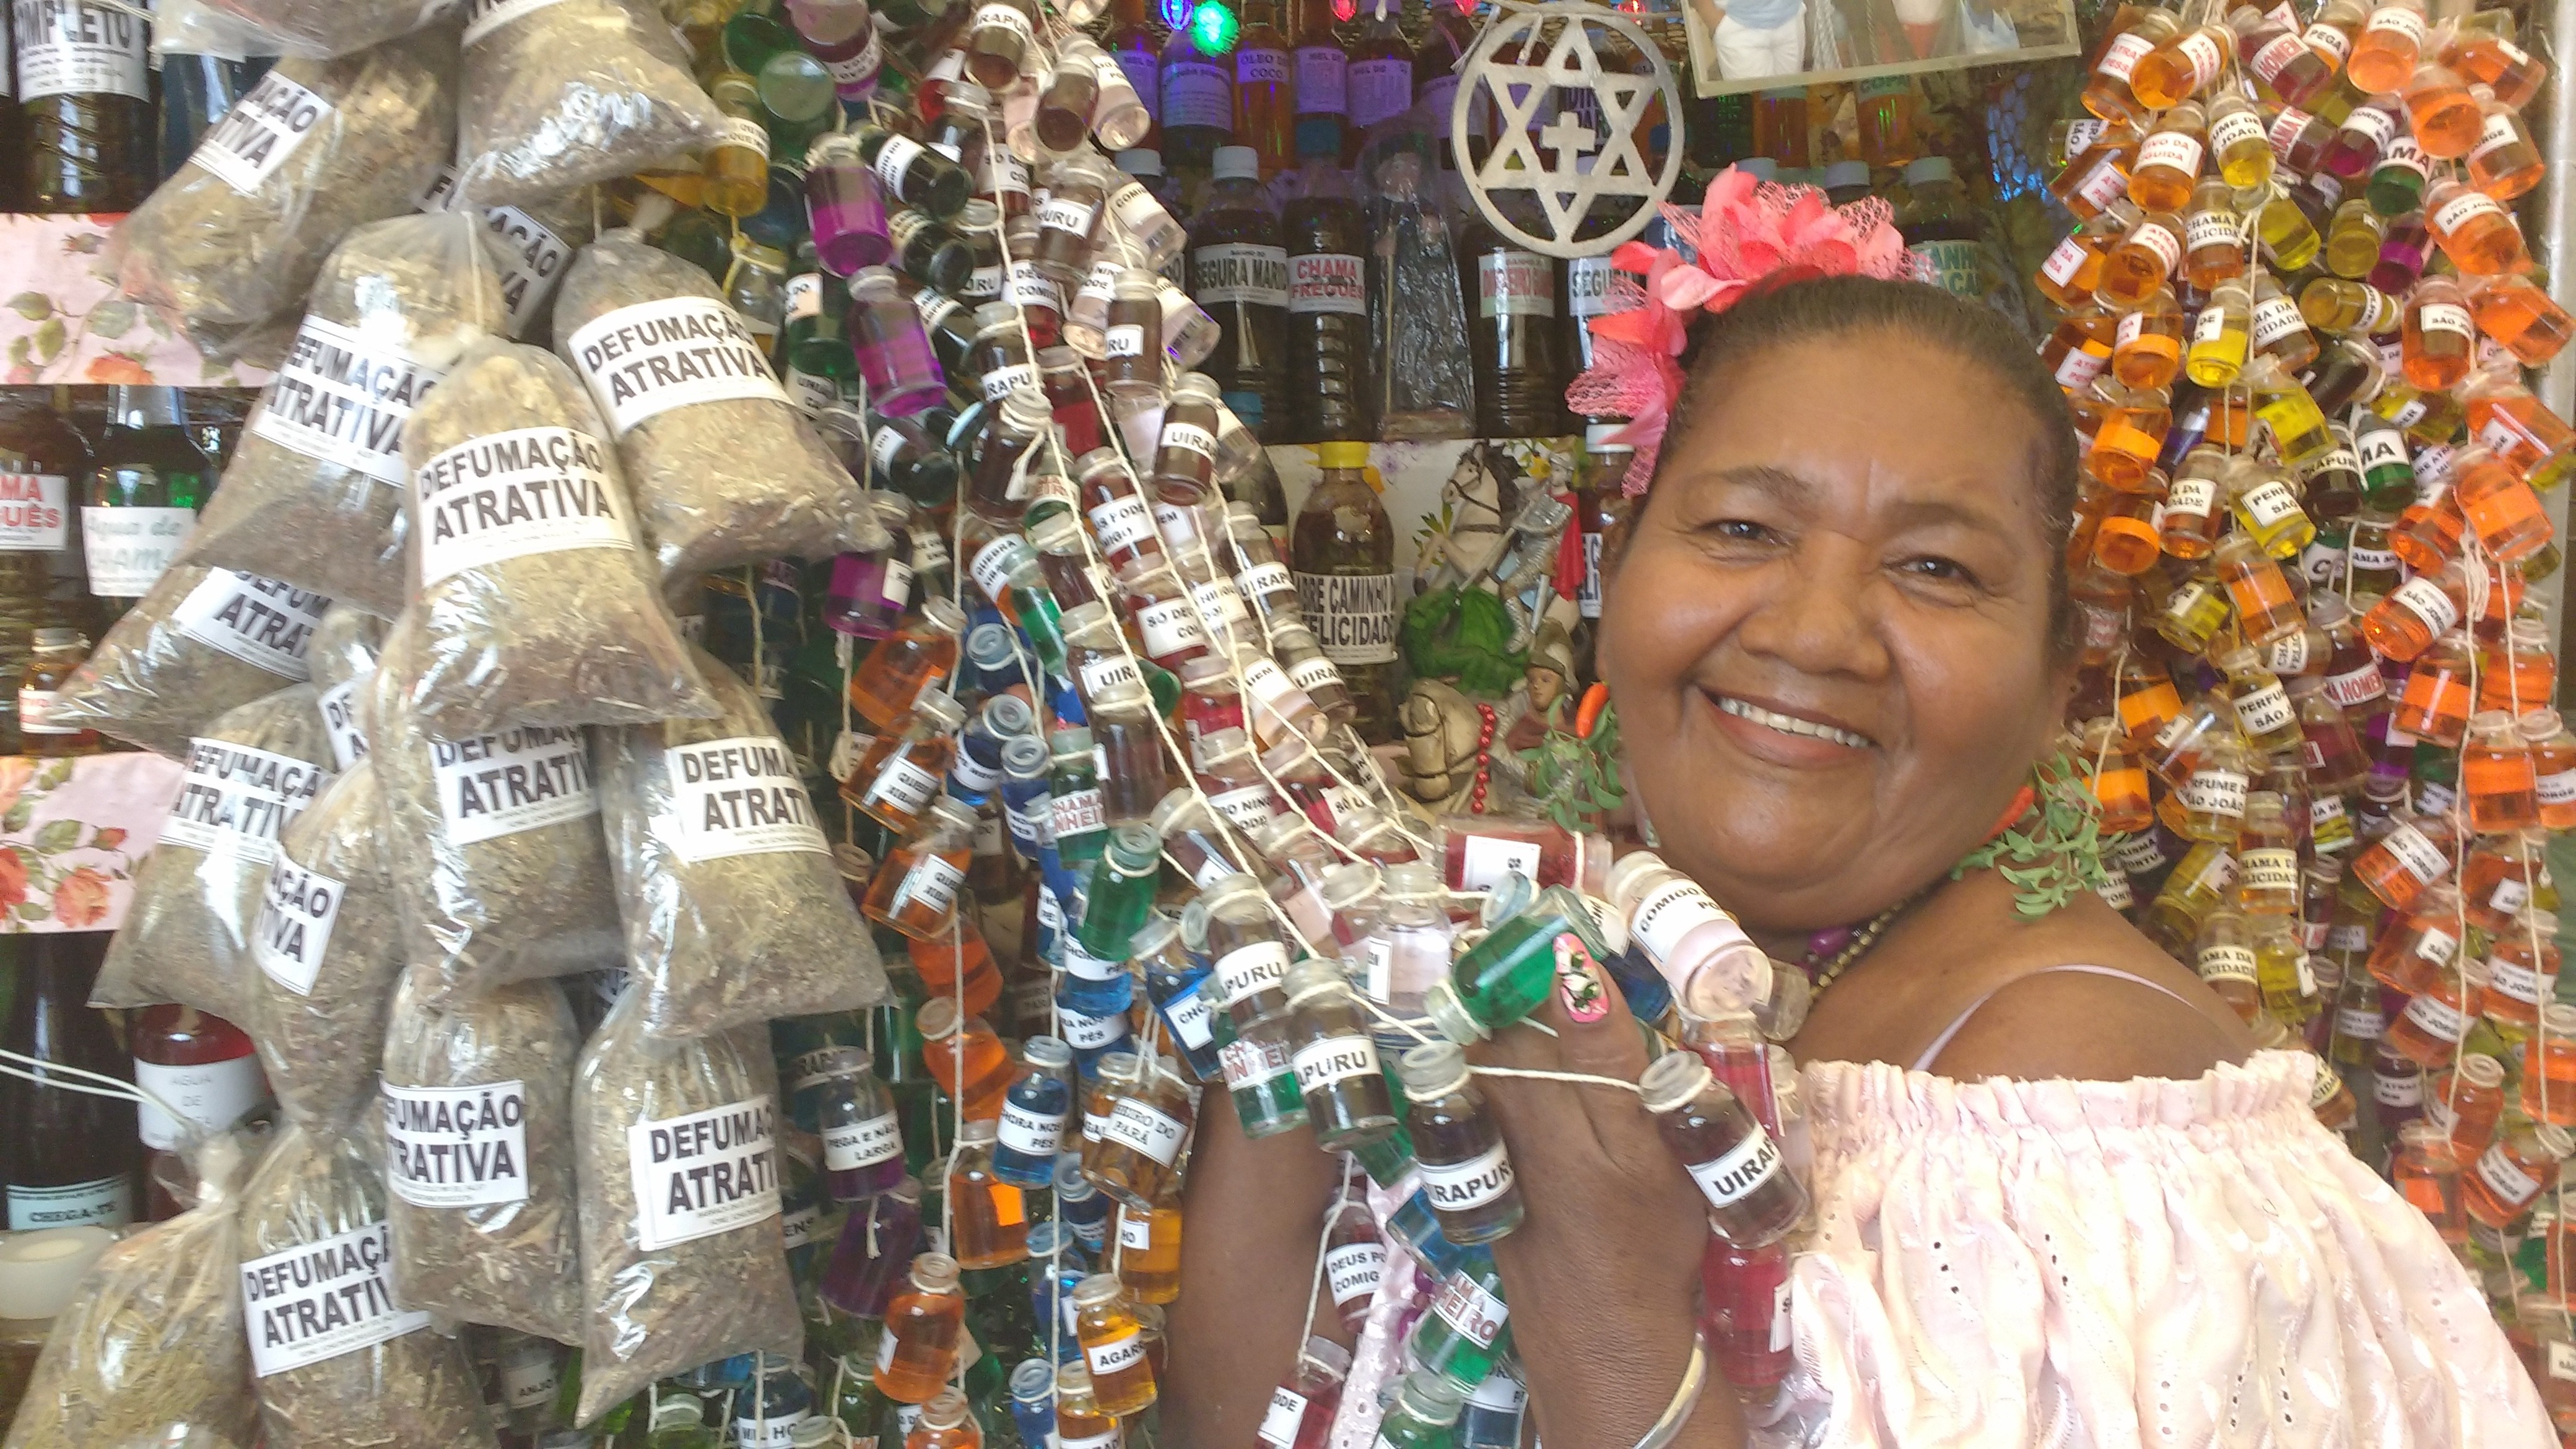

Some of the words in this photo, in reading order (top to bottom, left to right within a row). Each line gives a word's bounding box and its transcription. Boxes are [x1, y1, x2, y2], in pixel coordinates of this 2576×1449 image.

[2309, 29, 2342, 50] PEGA
[2213, 118, 2239, 141] UME
[1297, 259, 1357, 279] CHAMA
[579, 310, 753, 372] DEFUMAÇÃO
[606, 347, 774, 407] ATRATIVA
[1171, 430, 1218, 459] UIRA
[420, 432, 604, 500] DEFUMAÇÃO
[0, 474, 43, 501] MA
[3, 503, 59, 529] UÊS
[433, 477, 616, 545] ATRATIVA
[270, 868, 330, 918] ÇÃO
[1641, 887, 1700, 933] COMIGO
